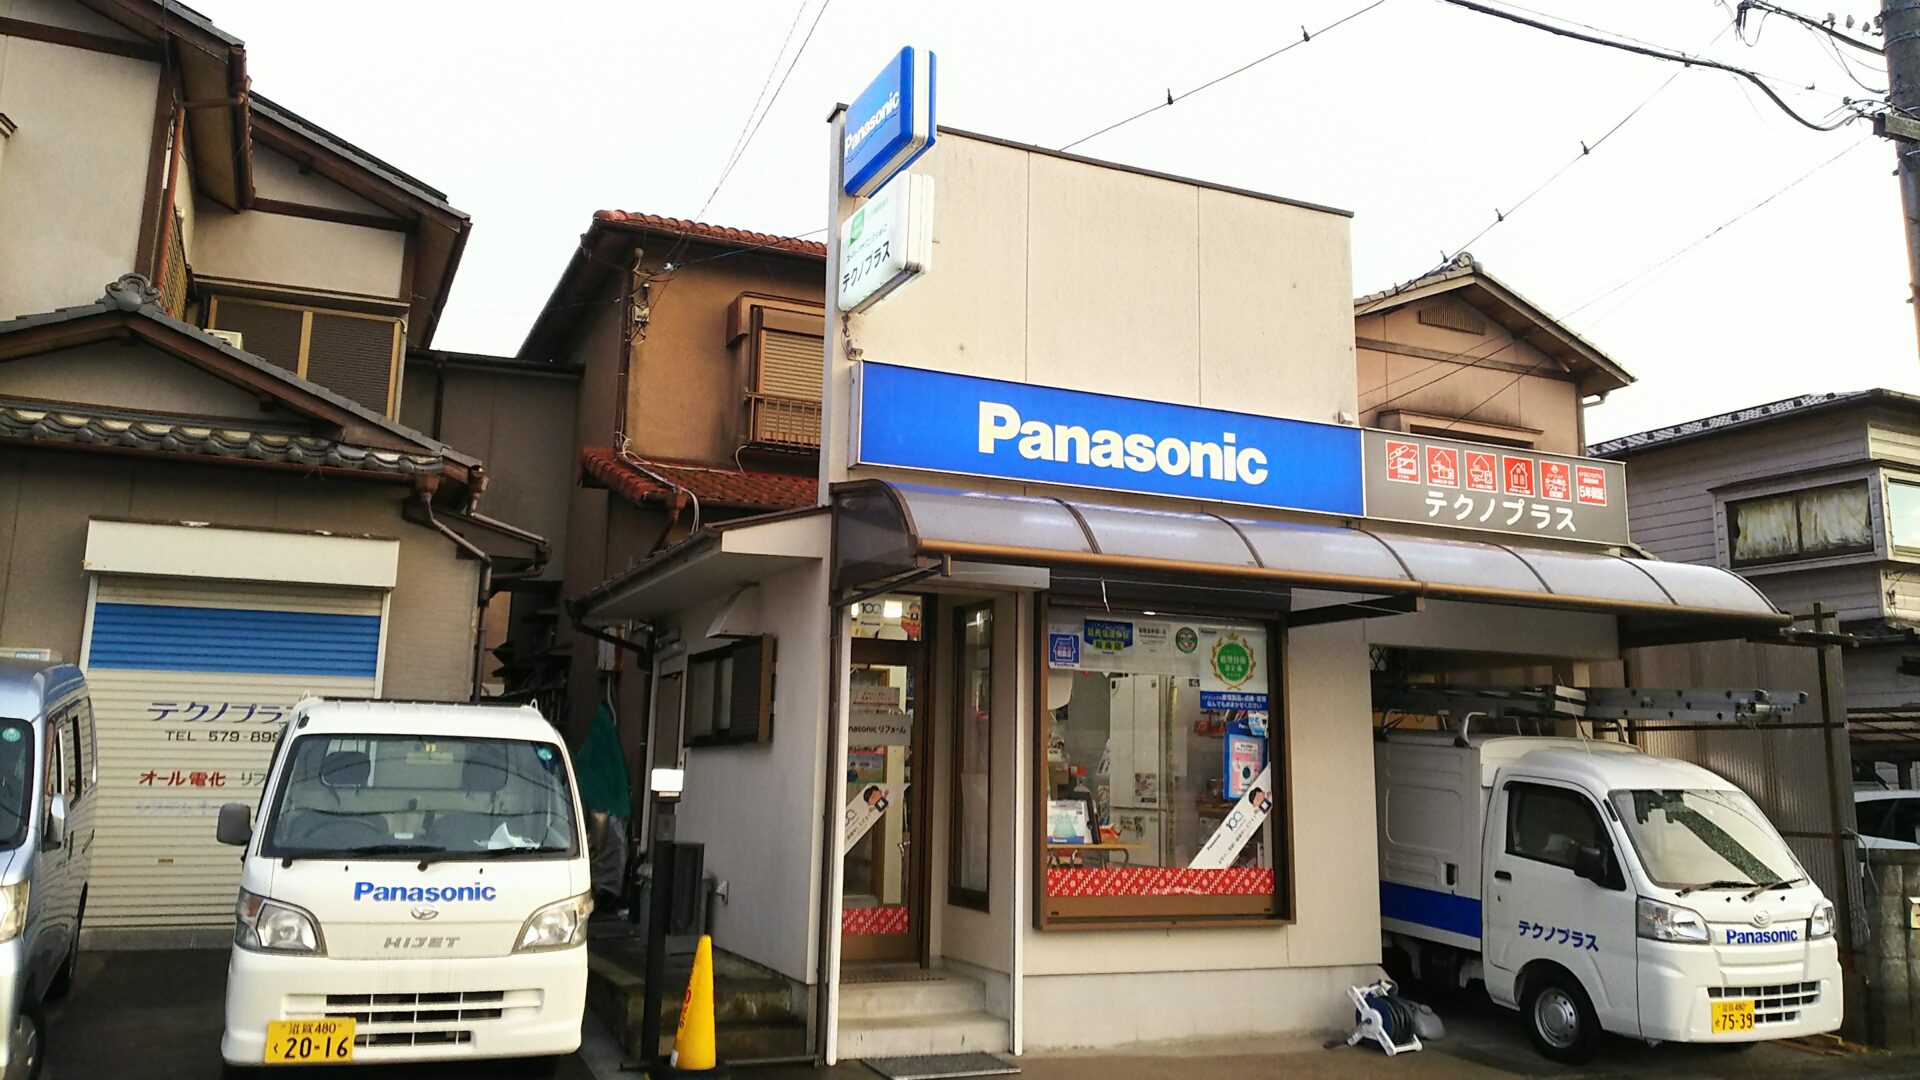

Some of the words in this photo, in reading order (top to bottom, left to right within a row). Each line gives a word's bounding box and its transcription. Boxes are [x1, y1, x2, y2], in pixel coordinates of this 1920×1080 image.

[844, 90, 900, 159] Panasonic
[842, 240, 890, 293] テクノプラス
[978, 400, 1269, 486] Panasonic
[1424, 490, 1577, 533] テクノプラス
[147, 701, 293, 725] テクノプラ
[165, 730, 197, 742] TEL
[139, 769, 227, 788] オール電化
[353, 881, 497, 904] Panasonic
[383, 935, 462, 949] HIJET
[1518, 918, 1600, 952] テクノプラス
[1726, 929, 1798, 945] Panasonic
[284, 1036, 350, 1060] 20-16
